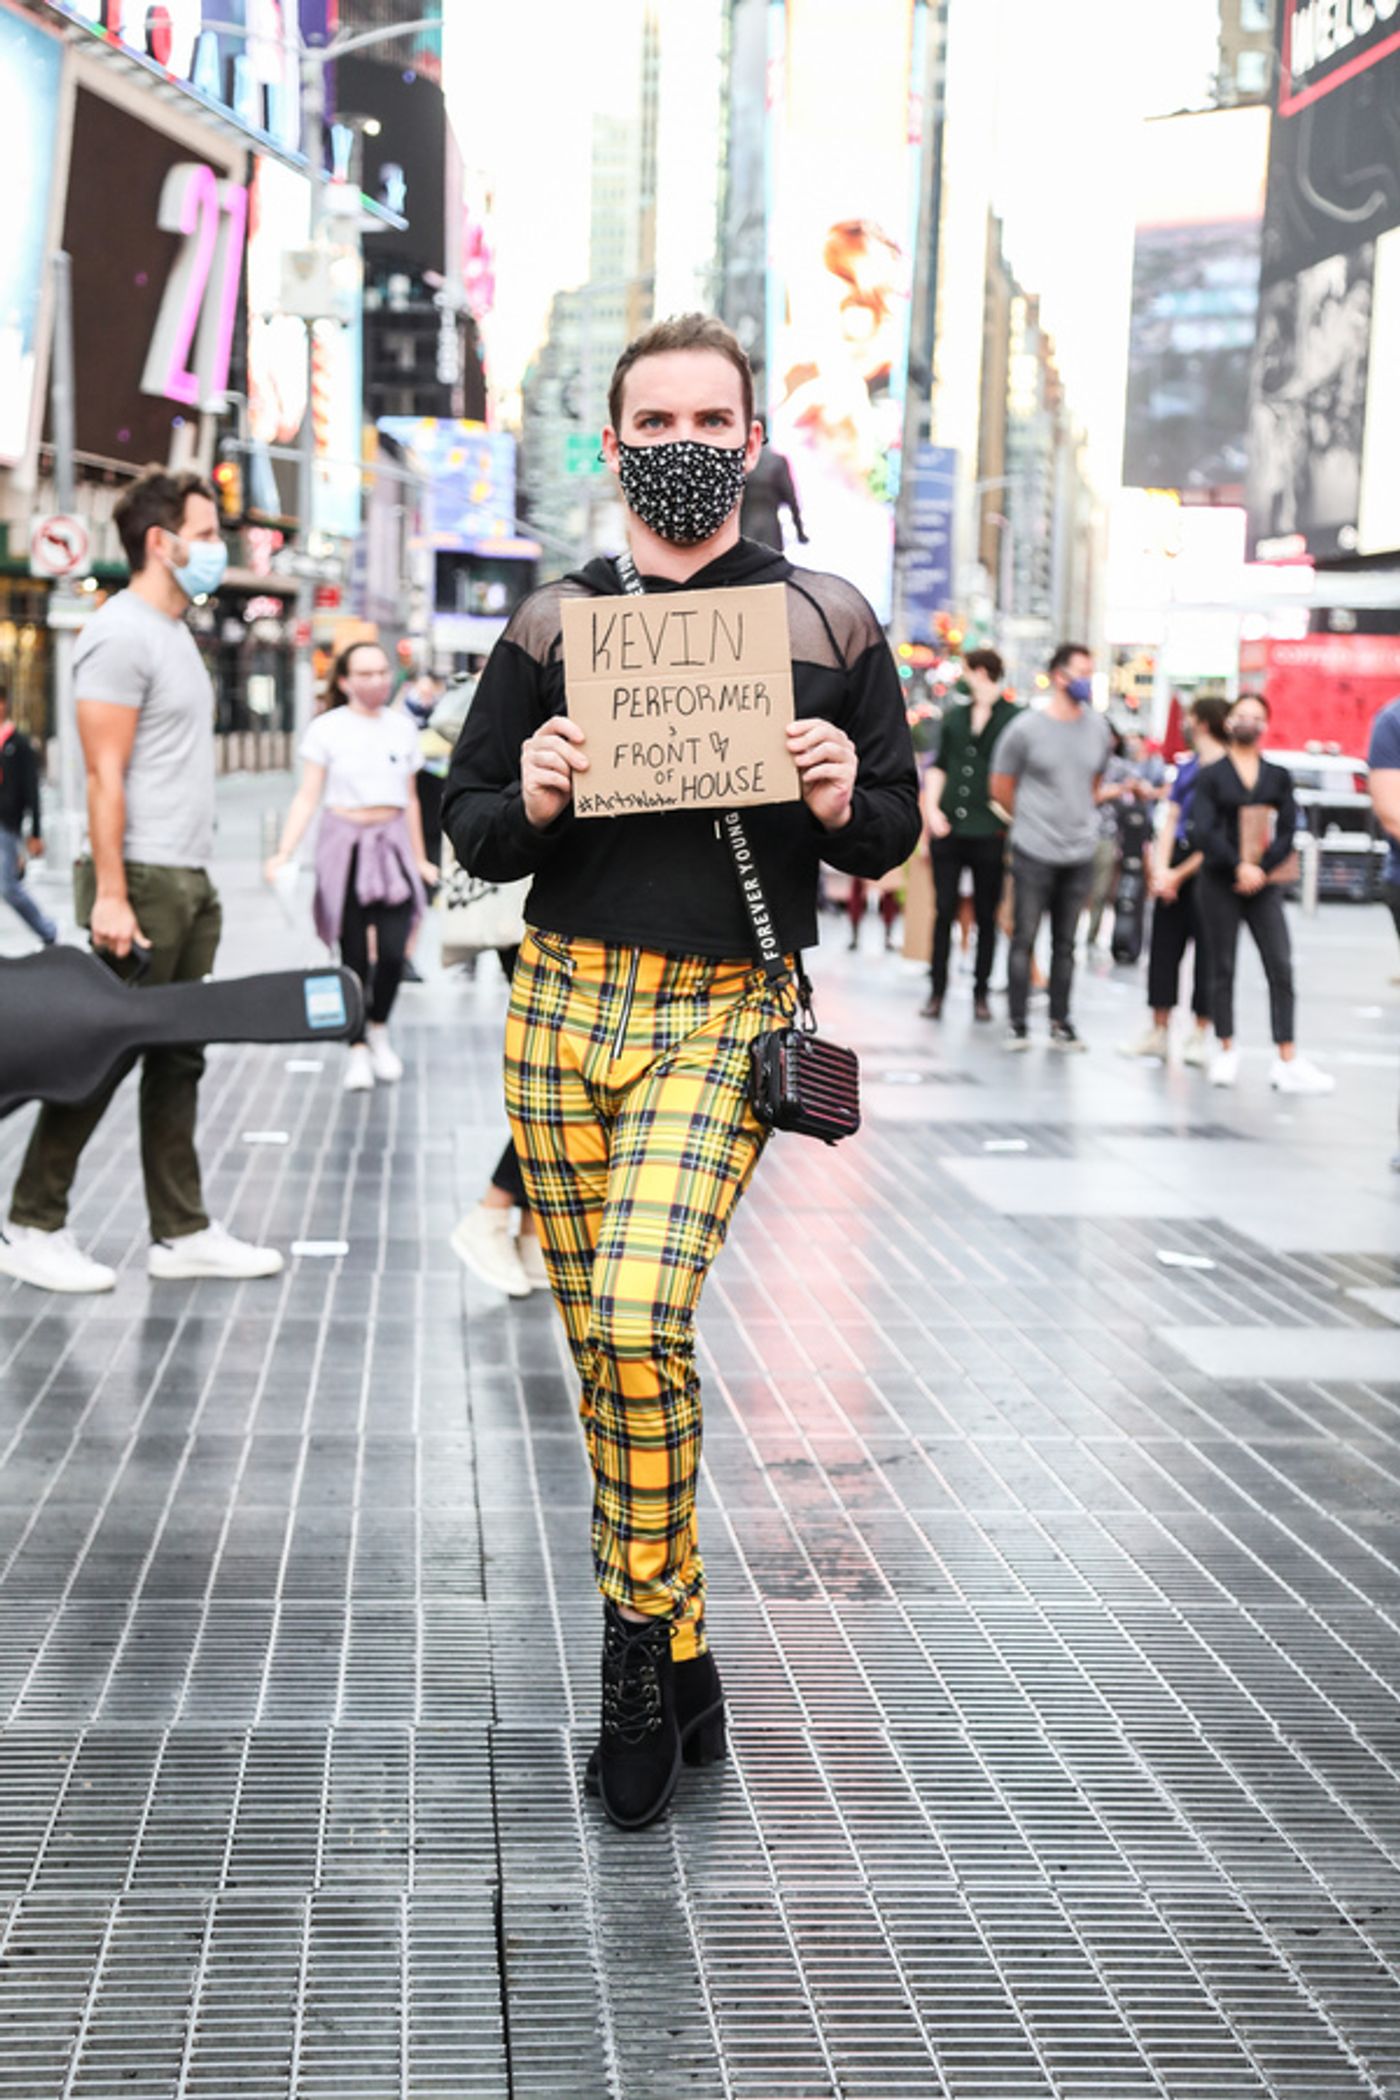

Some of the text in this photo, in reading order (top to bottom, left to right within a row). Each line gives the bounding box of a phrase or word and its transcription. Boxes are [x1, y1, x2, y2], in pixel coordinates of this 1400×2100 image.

[141, 162, 248, 408] 21
[592, 609, 743, 673] KEVIN
[612, 682, 771, 720] PERFORMER
[613, 737, 700, 769] FRONT
[654, 761, 765, 802] OF HOUSE
[725, 811, 779, 961] FOREVER YOUNG
